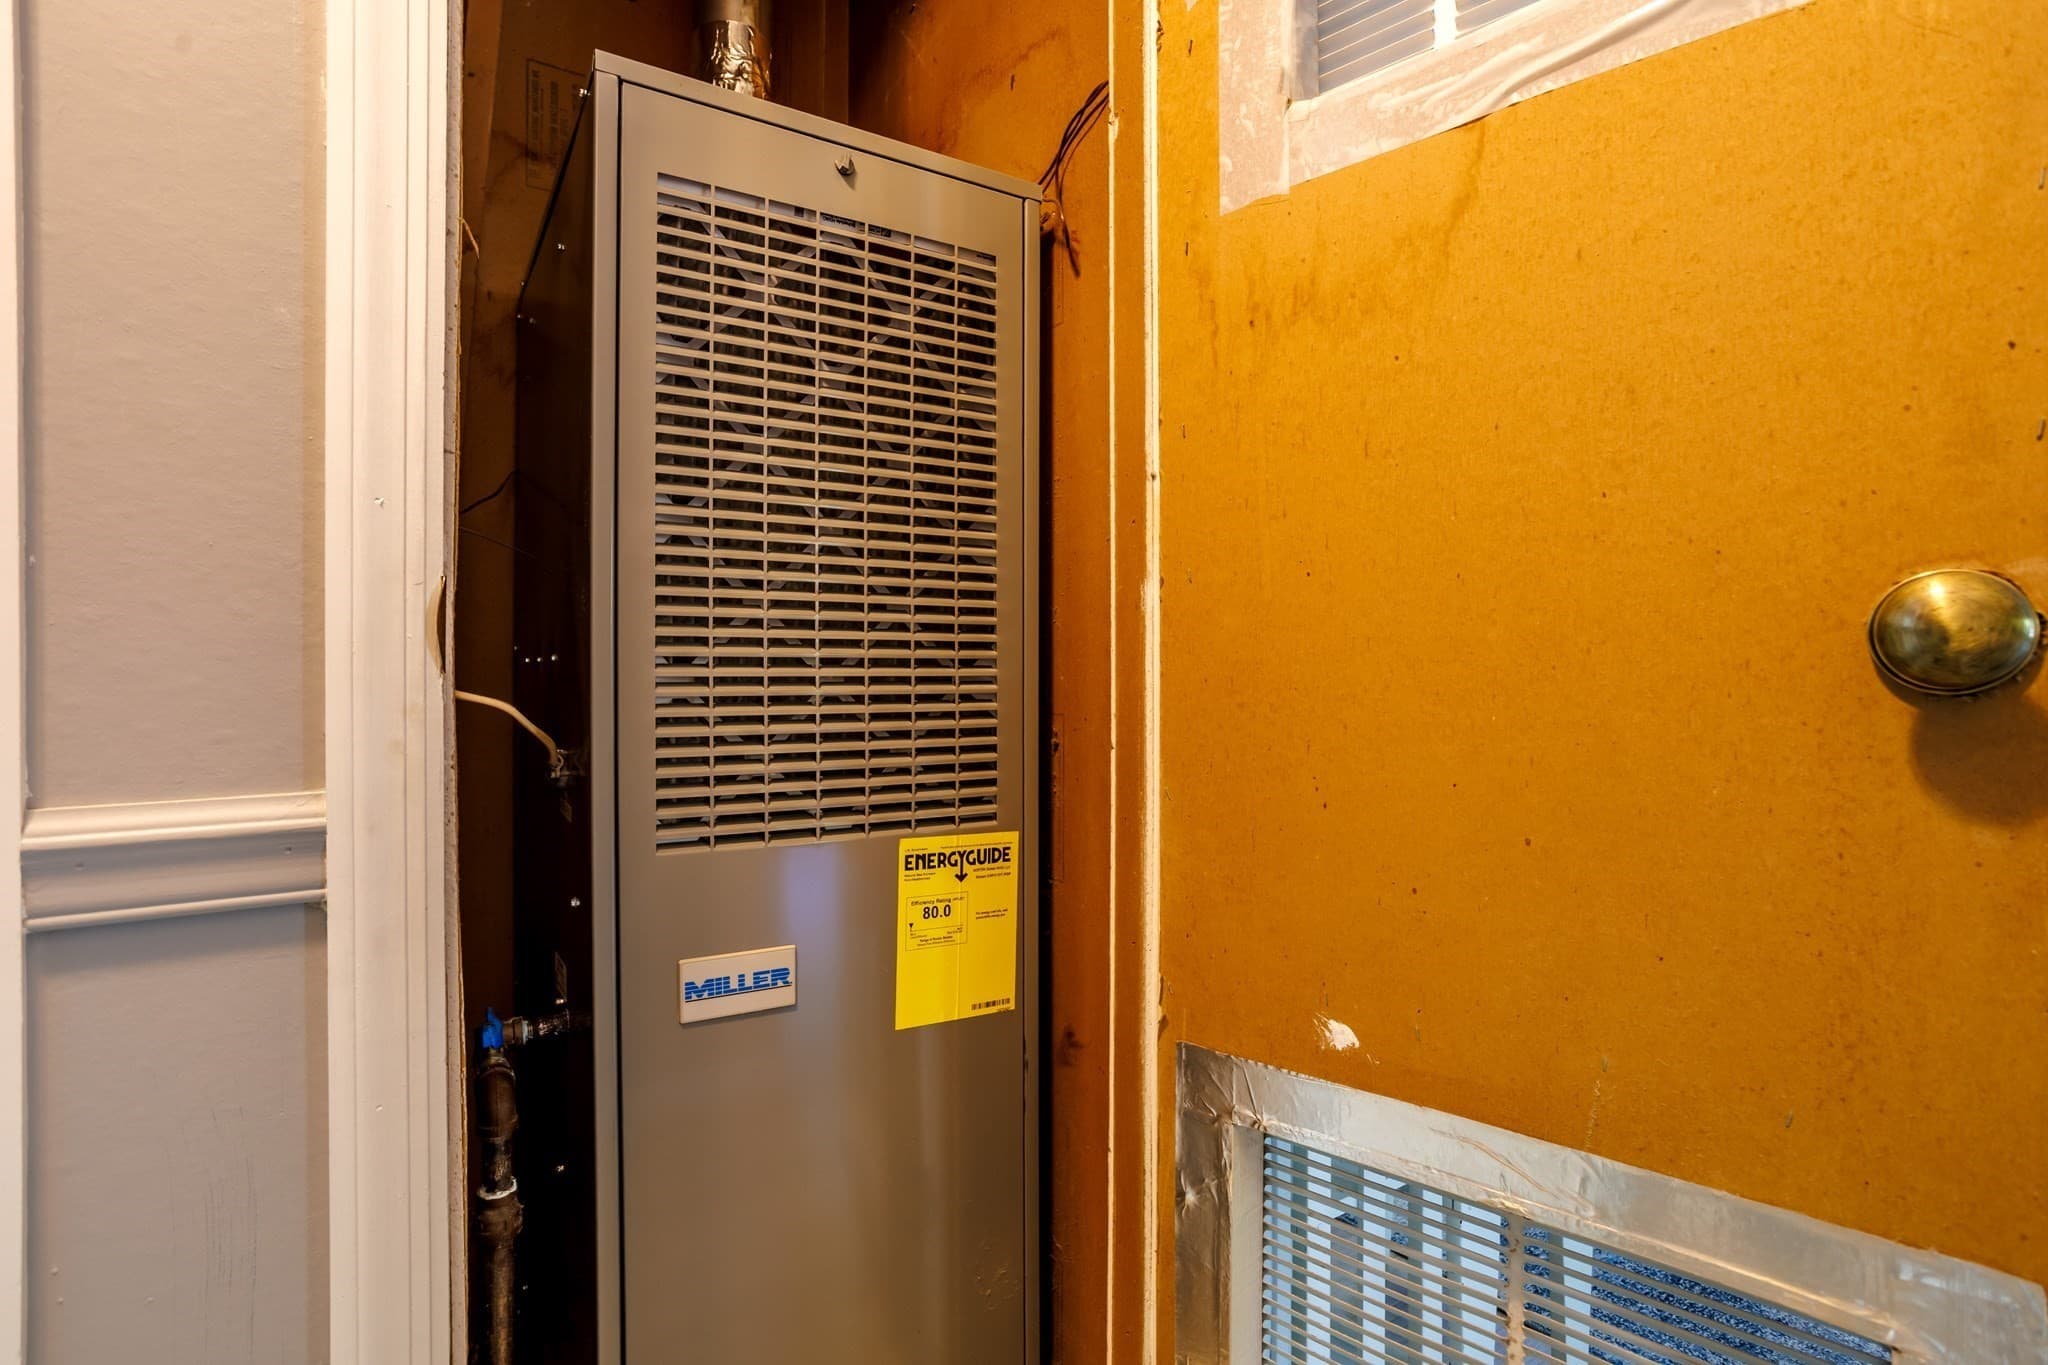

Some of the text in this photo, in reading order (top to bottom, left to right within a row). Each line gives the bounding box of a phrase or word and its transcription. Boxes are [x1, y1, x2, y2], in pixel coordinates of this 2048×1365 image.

[904, 847, 1011, 871] ENERGYGUIDE
[922, 904, 951, 919] 80.0
[684, 967, 791, 1000] MILLER
